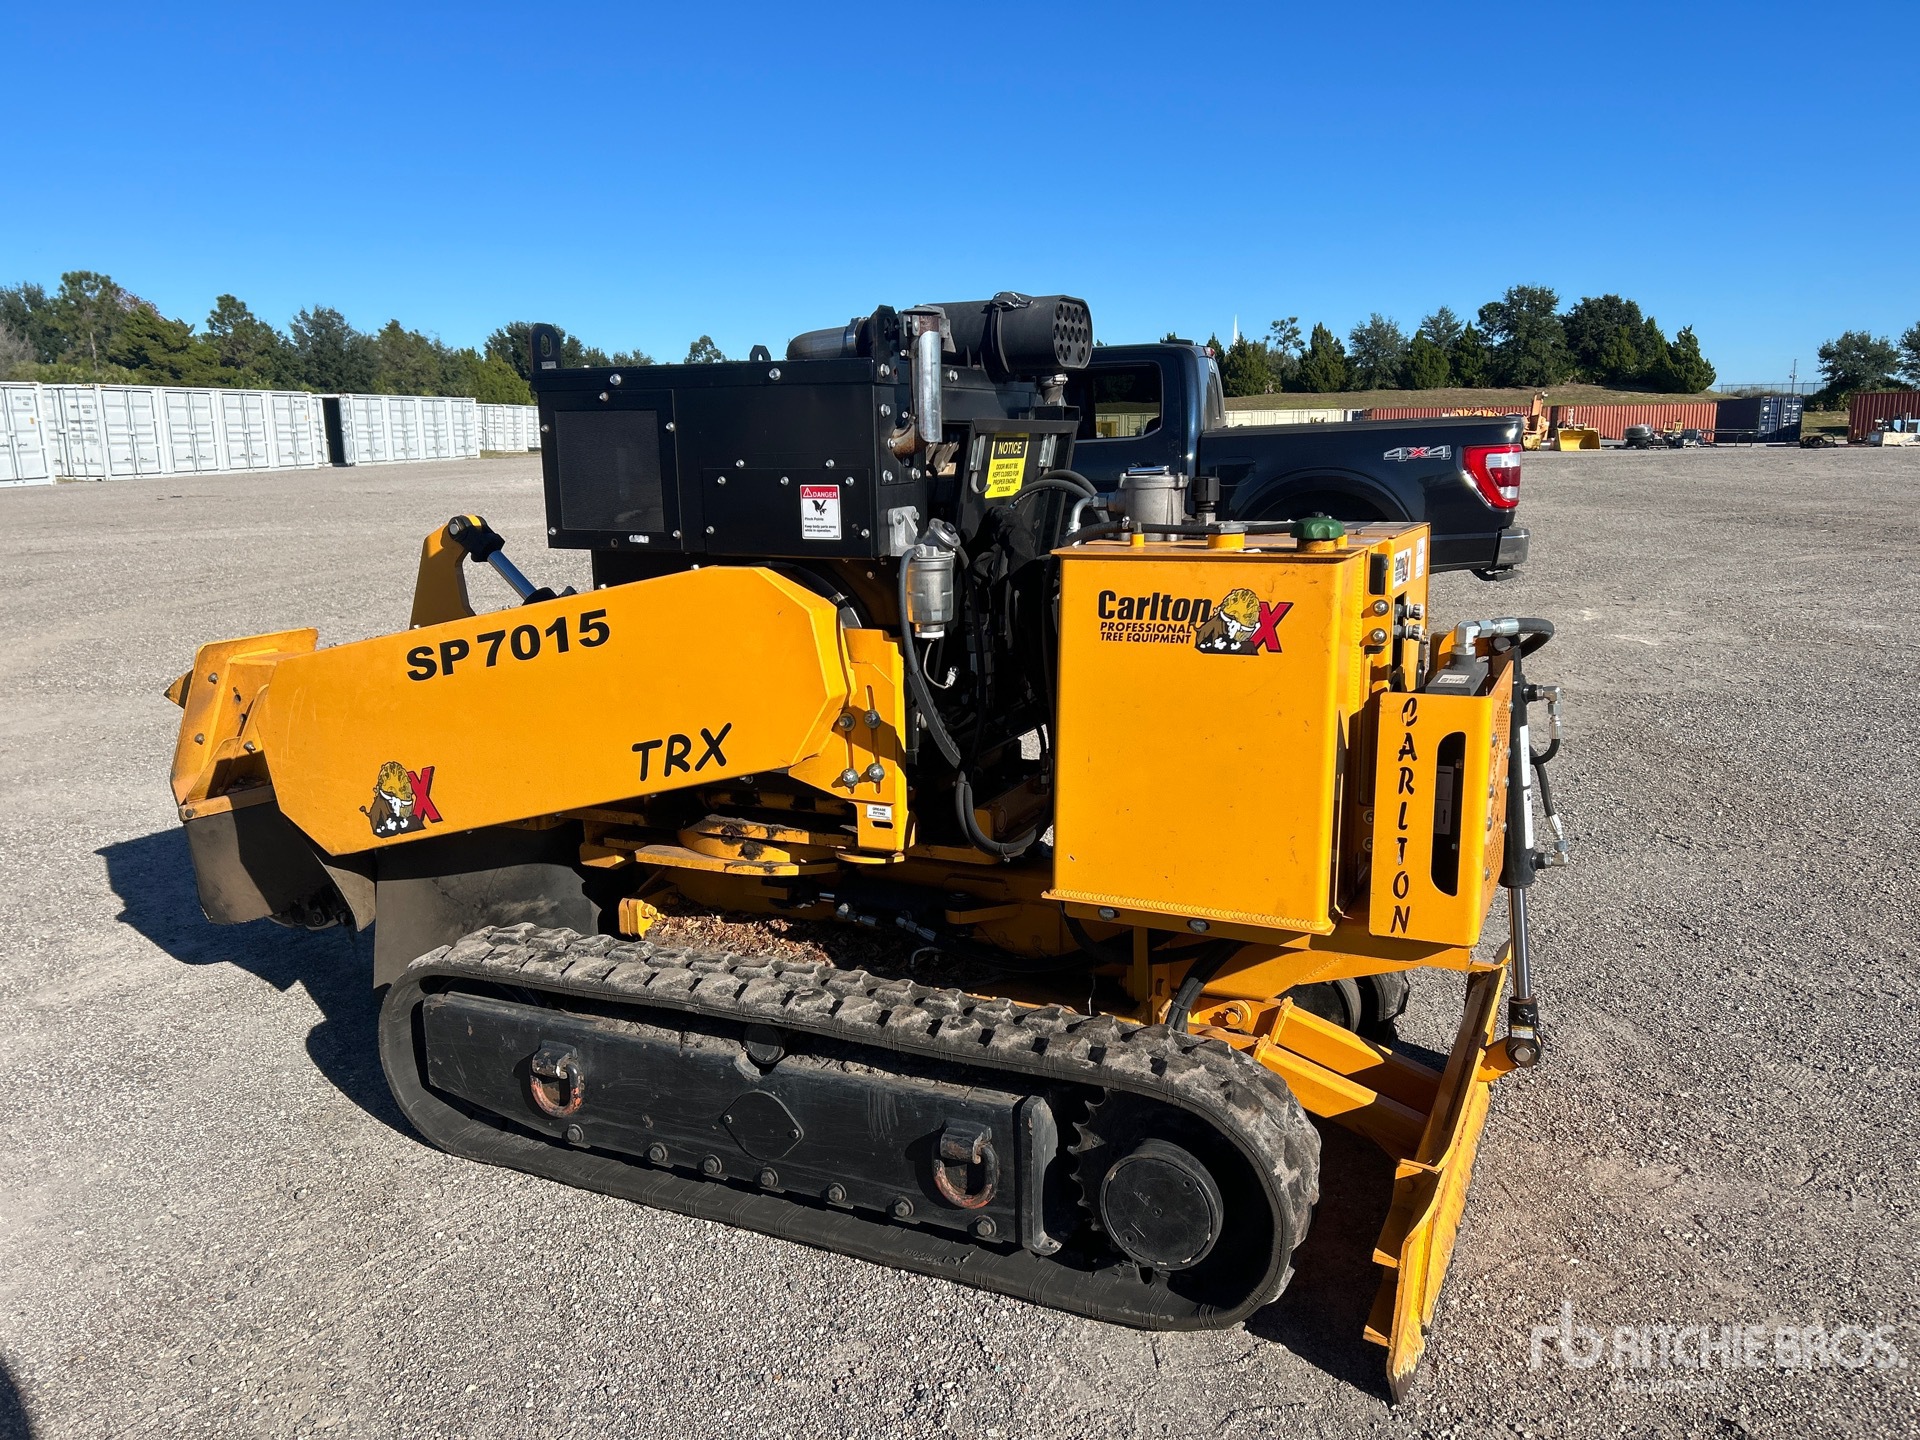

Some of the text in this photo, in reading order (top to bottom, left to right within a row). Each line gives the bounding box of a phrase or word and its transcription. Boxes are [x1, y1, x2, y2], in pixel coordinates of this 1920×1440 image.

[997, 441, 1022, 454] NOTICE
[1098, 590, 1212, 623] Carlton
[1100, 622, 1192, 634] PROFESSIONAL
[1101, 632, 1192, 644] TREE EQUIPMENT
[631, 722, 732, 782] TRX
[1390, 697, 1418, 934] CARLTON
